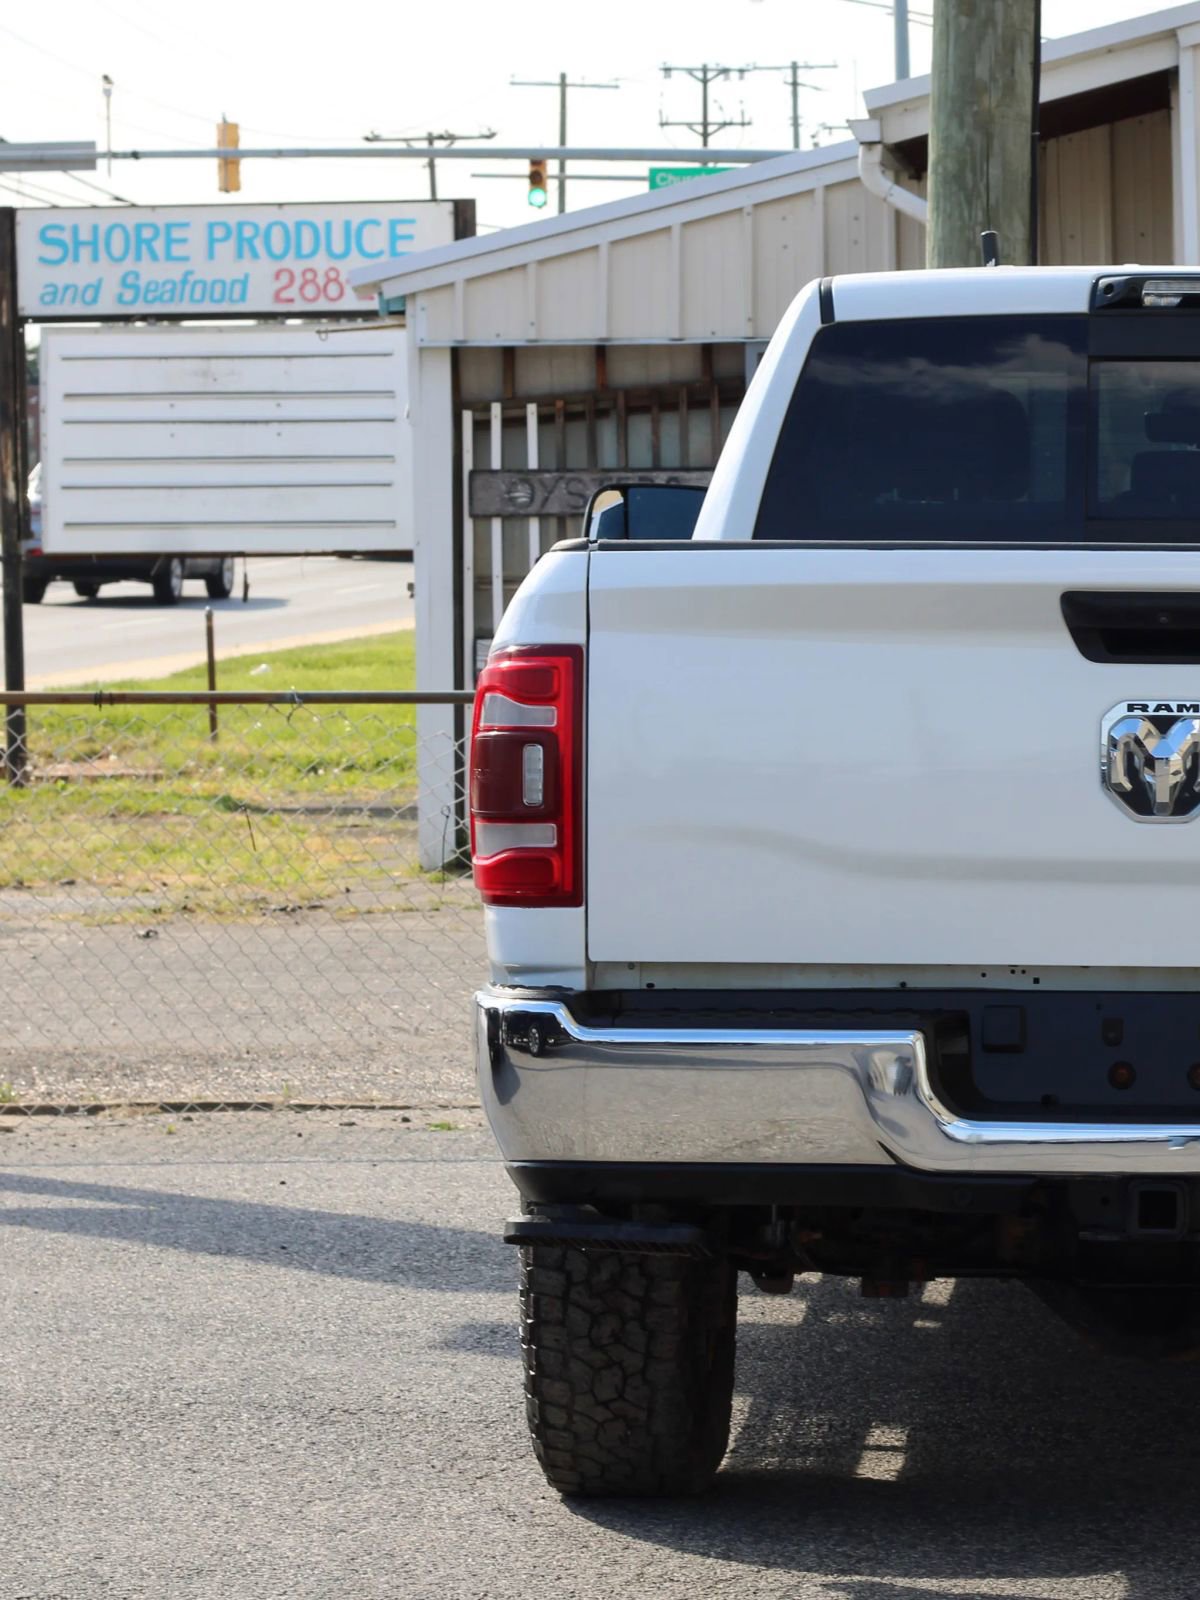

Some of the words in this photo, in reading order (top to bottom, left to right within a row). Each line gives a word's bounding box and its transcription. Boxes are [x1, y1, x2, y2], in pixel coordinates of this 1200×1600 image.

[37, 220, 192, 265] SHORE
[207, 218, 418, 261] PRODUCE
[40, 278, 103, 306] and
[116, 269, 250, 305] Seafood
[273, 266, 374, 304] 288
[1127, 703, 1200, 713] RAM
